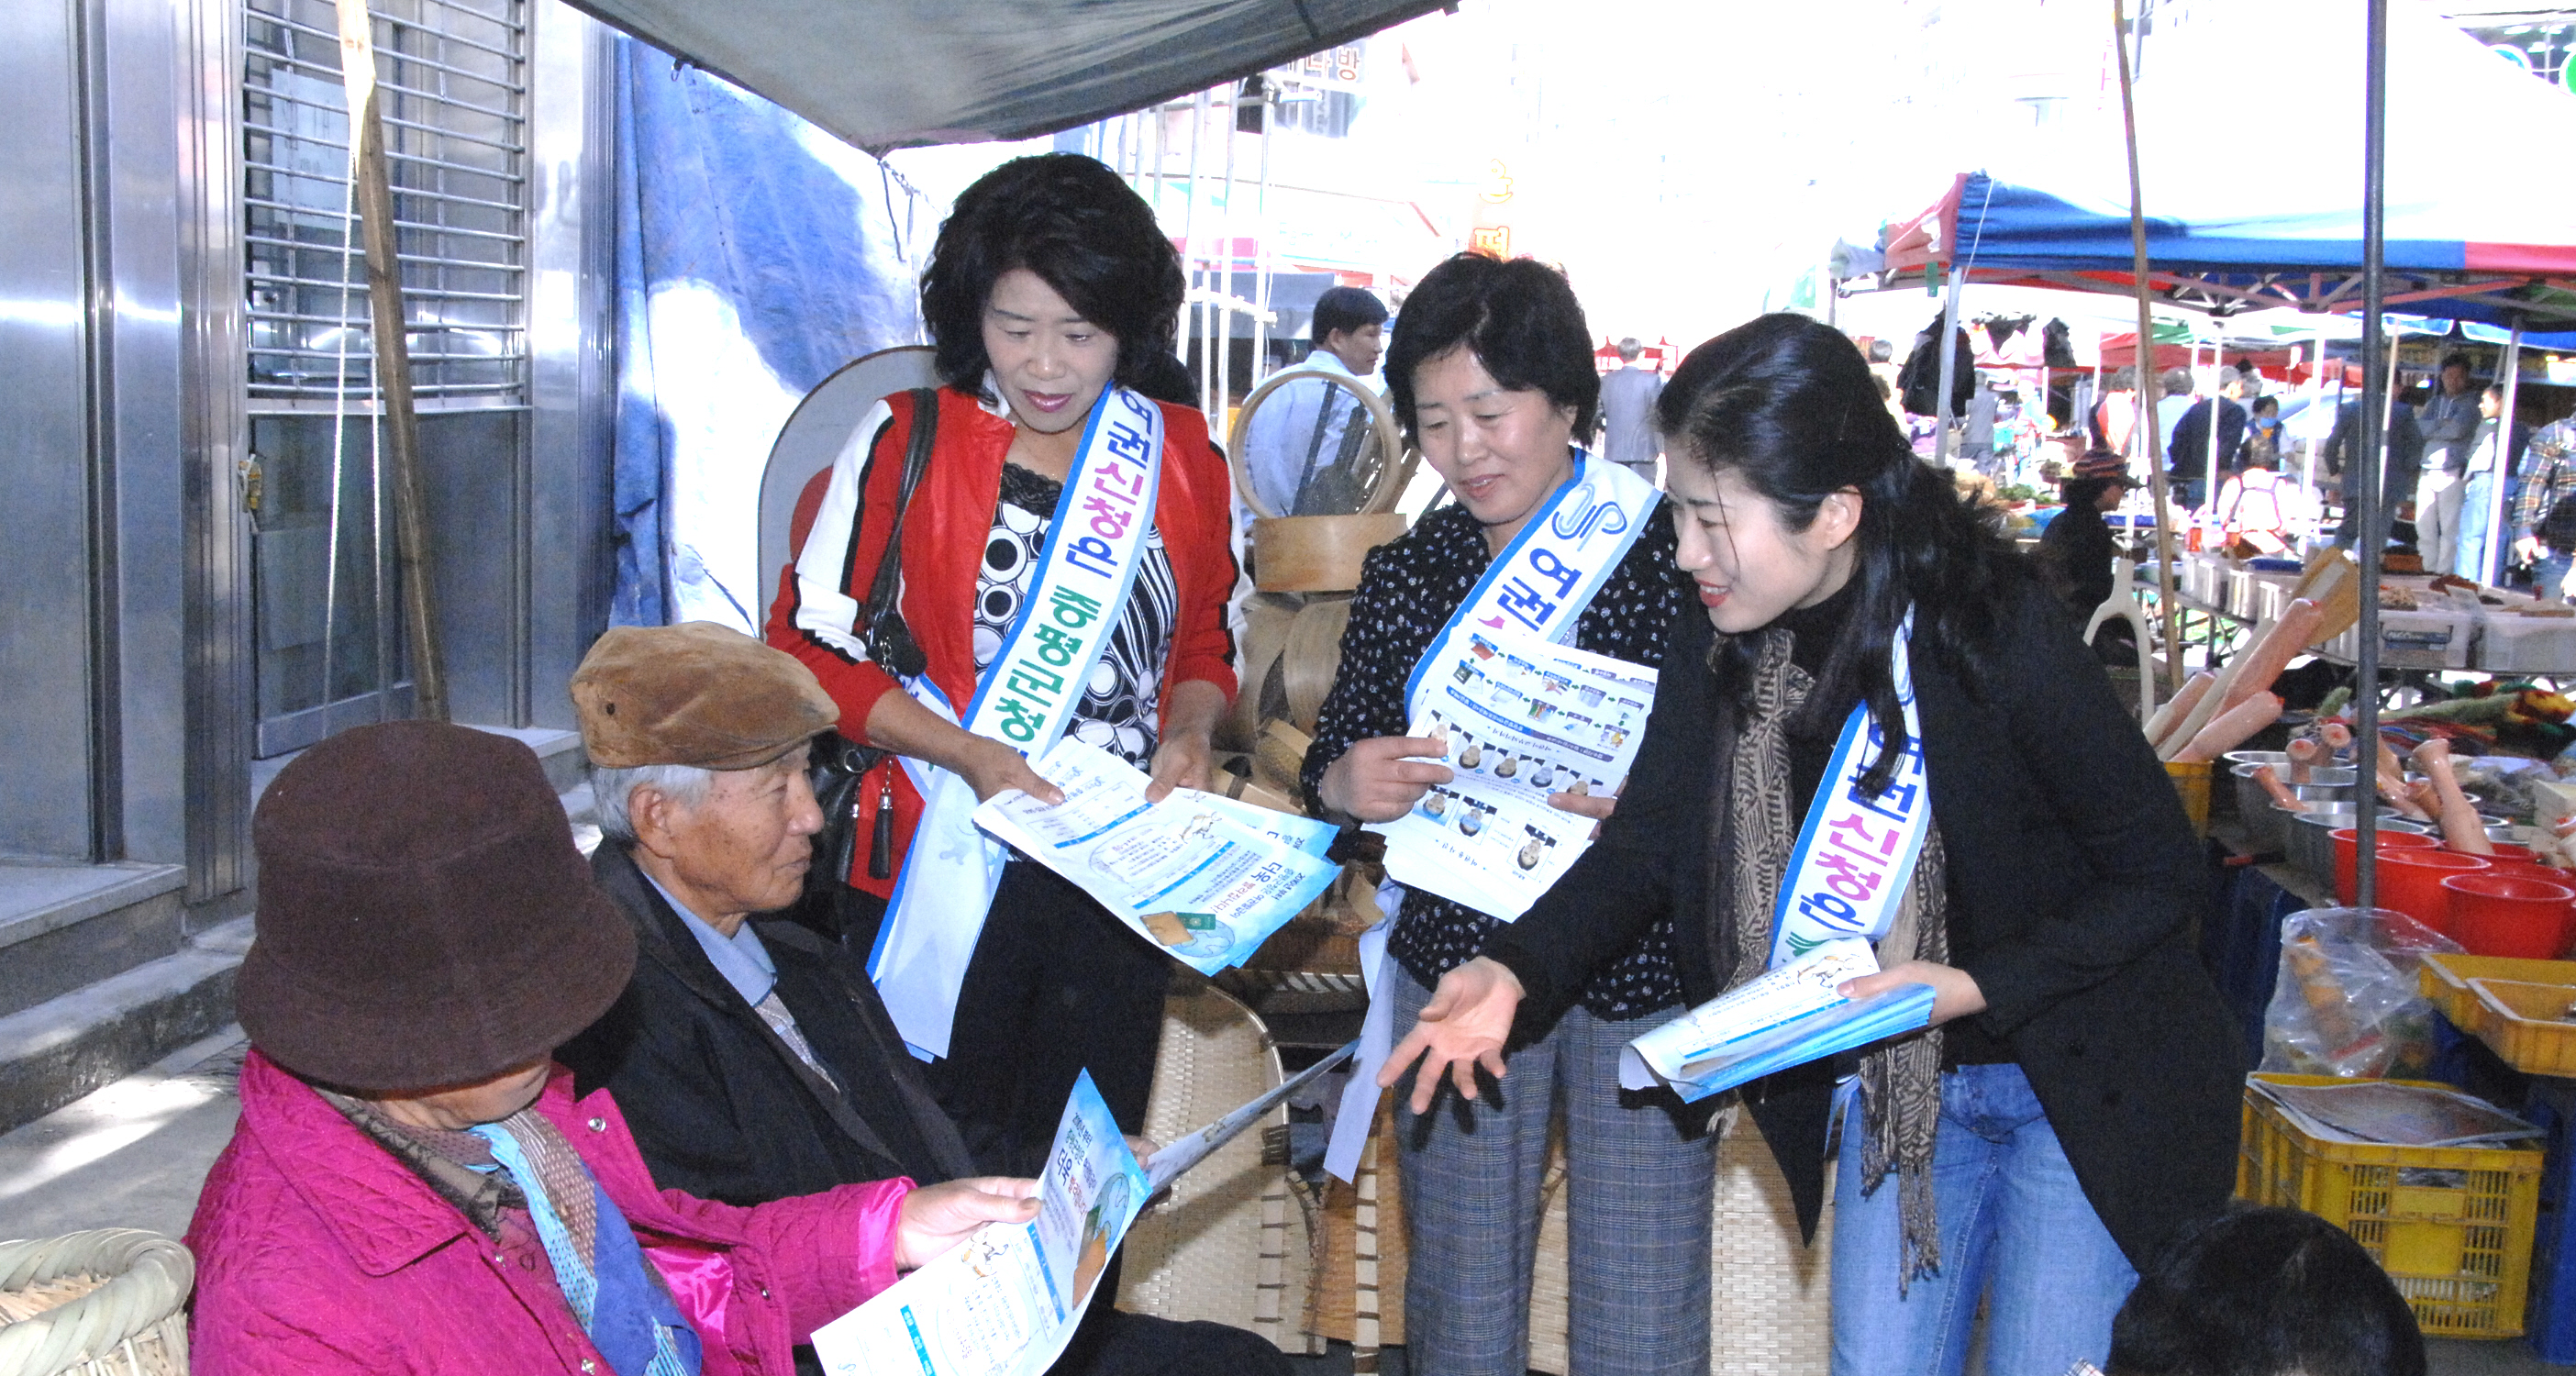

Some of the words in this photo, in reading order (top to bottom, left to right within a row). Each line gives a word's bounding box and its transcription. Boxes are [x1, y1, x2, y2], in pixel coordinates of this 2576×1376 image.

[1065, 390, 1153, 580] 여권신청은
[1479, 548, 1583, 633] 여권
[994, 584, 1103, 758] 증평군청
[1249, 860, 1283, 885] 더욱
[1260, 867, 1294, 896] 증평군청은
[1208, 880, 1255, 914] 빨라집니다!
[1228, 891, 1263, 920] 여권발급이
[1057, 1147, 1073, 1185] 더욱
